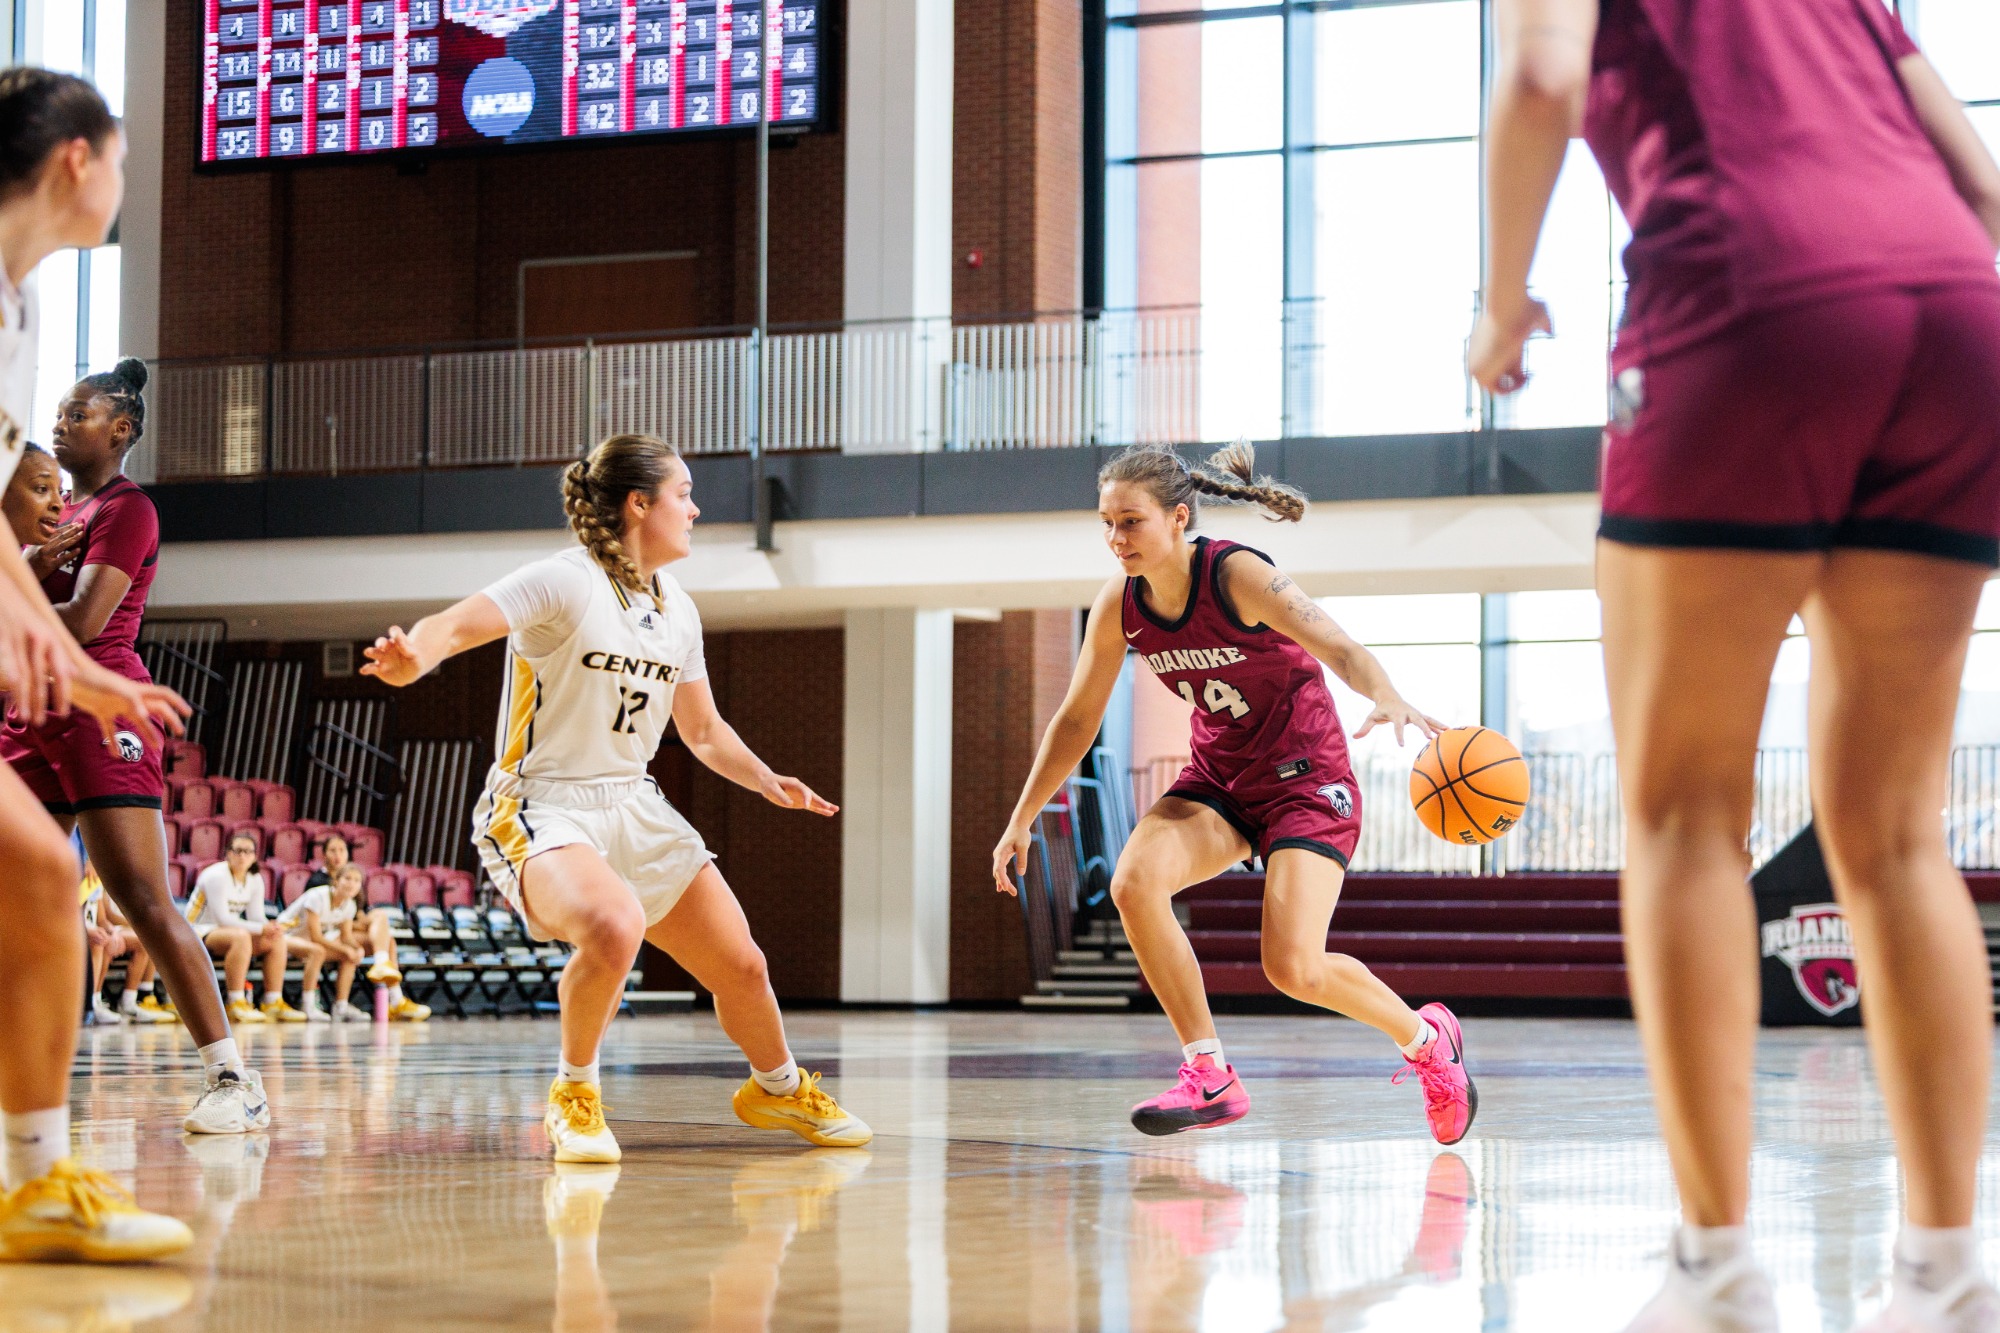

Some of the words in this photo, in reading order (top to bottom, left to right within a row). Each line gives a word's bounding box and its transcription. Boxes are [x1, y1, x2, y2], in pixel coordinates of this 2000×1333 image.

[585, 62, 616, 89] 32
[643, 58, 669, 85] 18
[699, 55, 707, 80] 1
[741, 51, 758, 78] 2
[788, 47, 807, 74] 4
[227, 91, 251, 116] 15
[279, 87, 295, 112] 6
[323, 84, 339, 109] 2
[374, 80, 382, 105] 1
[413, 77, 430, 102] 2
[583, 103, 615, 130] 42
[691, 96, 710, 123] 2
[740, 93, 758, 119] 0
[788, 89, 807, 115] 2
[222, 130, 250, 156] 35
[278, 127, 295, 152] 9
[323, 124, 339, 149] 2
[368, 120, 384, 146] 0
[413, 117, 429, 142] 5
[612, 686, 649, 734] 12
[1177, 678, 1251, 720] 14
